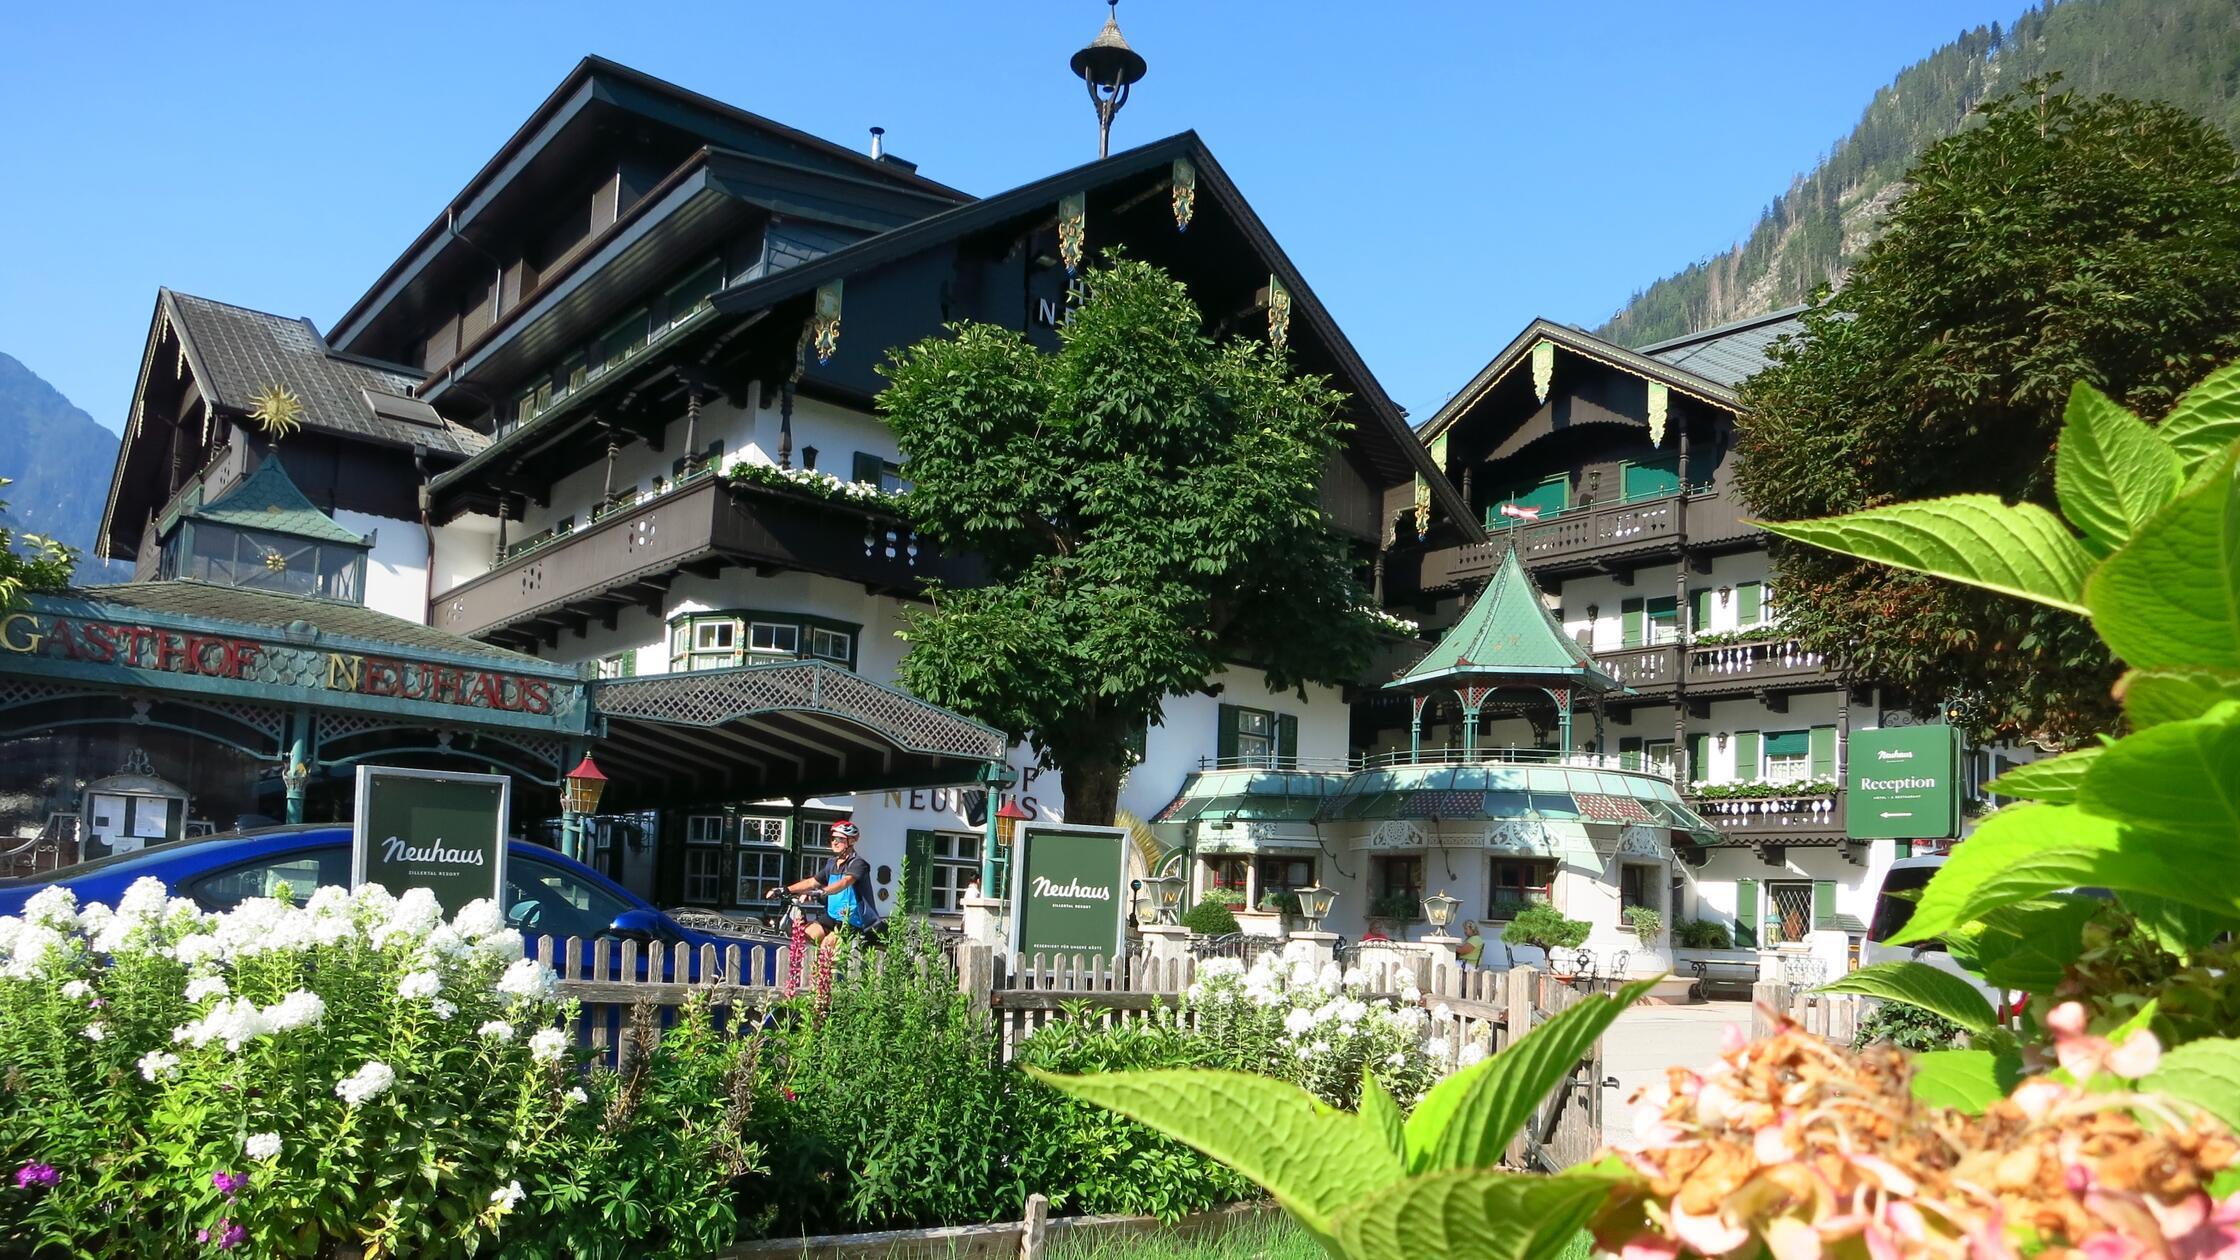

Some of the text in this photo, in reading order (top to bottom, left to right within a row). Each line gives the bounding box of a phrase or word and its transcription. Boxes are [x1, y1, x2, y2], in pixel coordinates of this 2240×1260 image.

[0, 614, 550, 714] GASTHOF NEUHAUS
[1861, 776, 1935, 793] Reception
[381, 836, 484, 866] Neuhaus
[1032, 876, 1110, 901] Neuhaus
